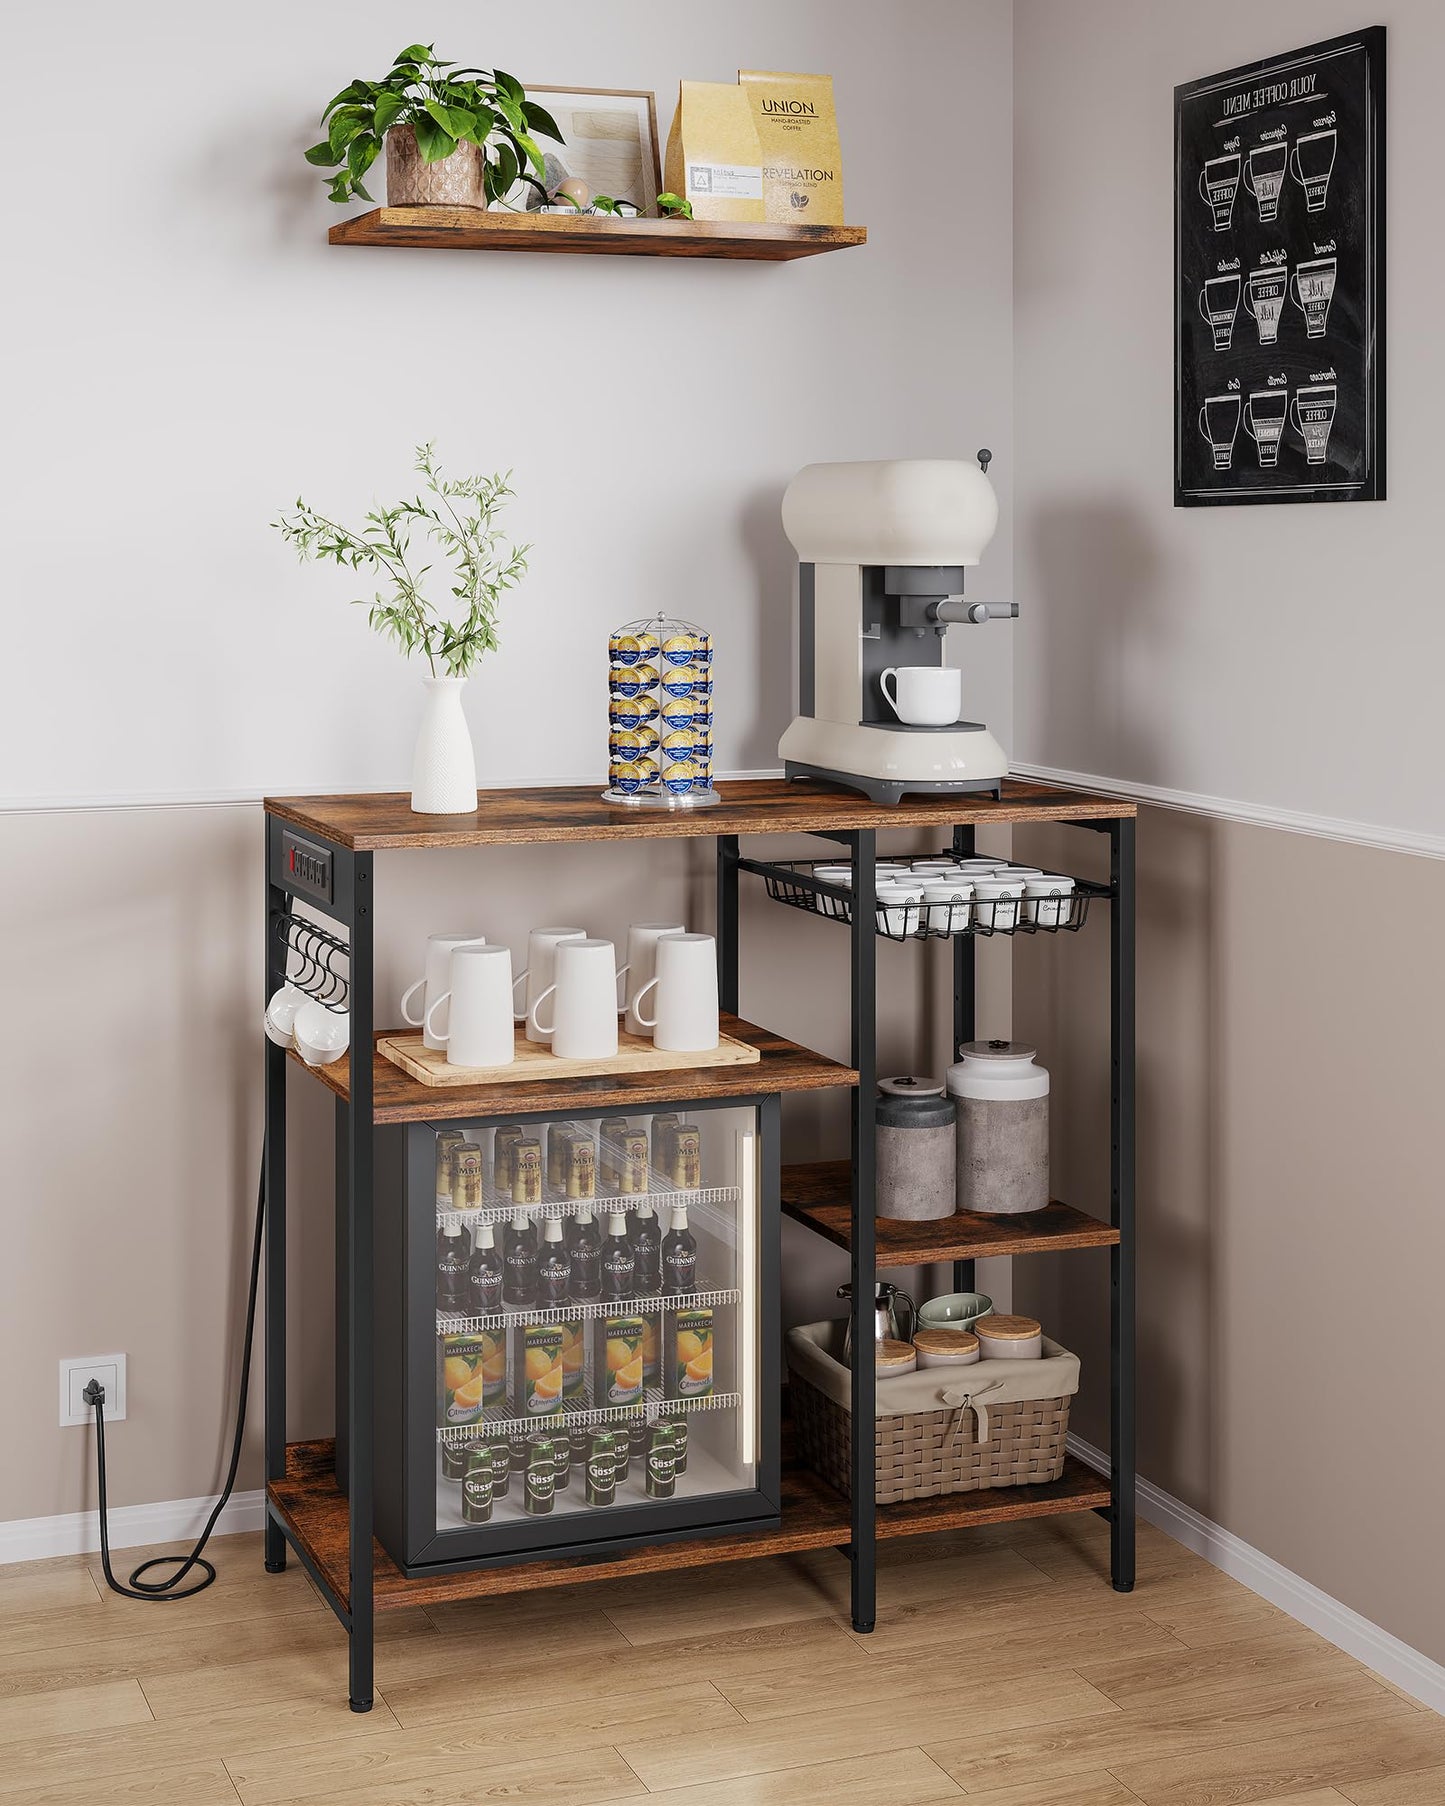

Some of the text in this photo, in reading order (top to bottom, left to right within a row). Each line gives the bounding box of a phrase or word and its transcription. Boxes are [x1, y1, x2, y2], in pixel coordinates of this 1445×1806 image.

[762, 99, 815, 114] UNION
[763, 167, 833, 181] REVELATION
[679, 1319, 712, 1329] MARRAKECH
